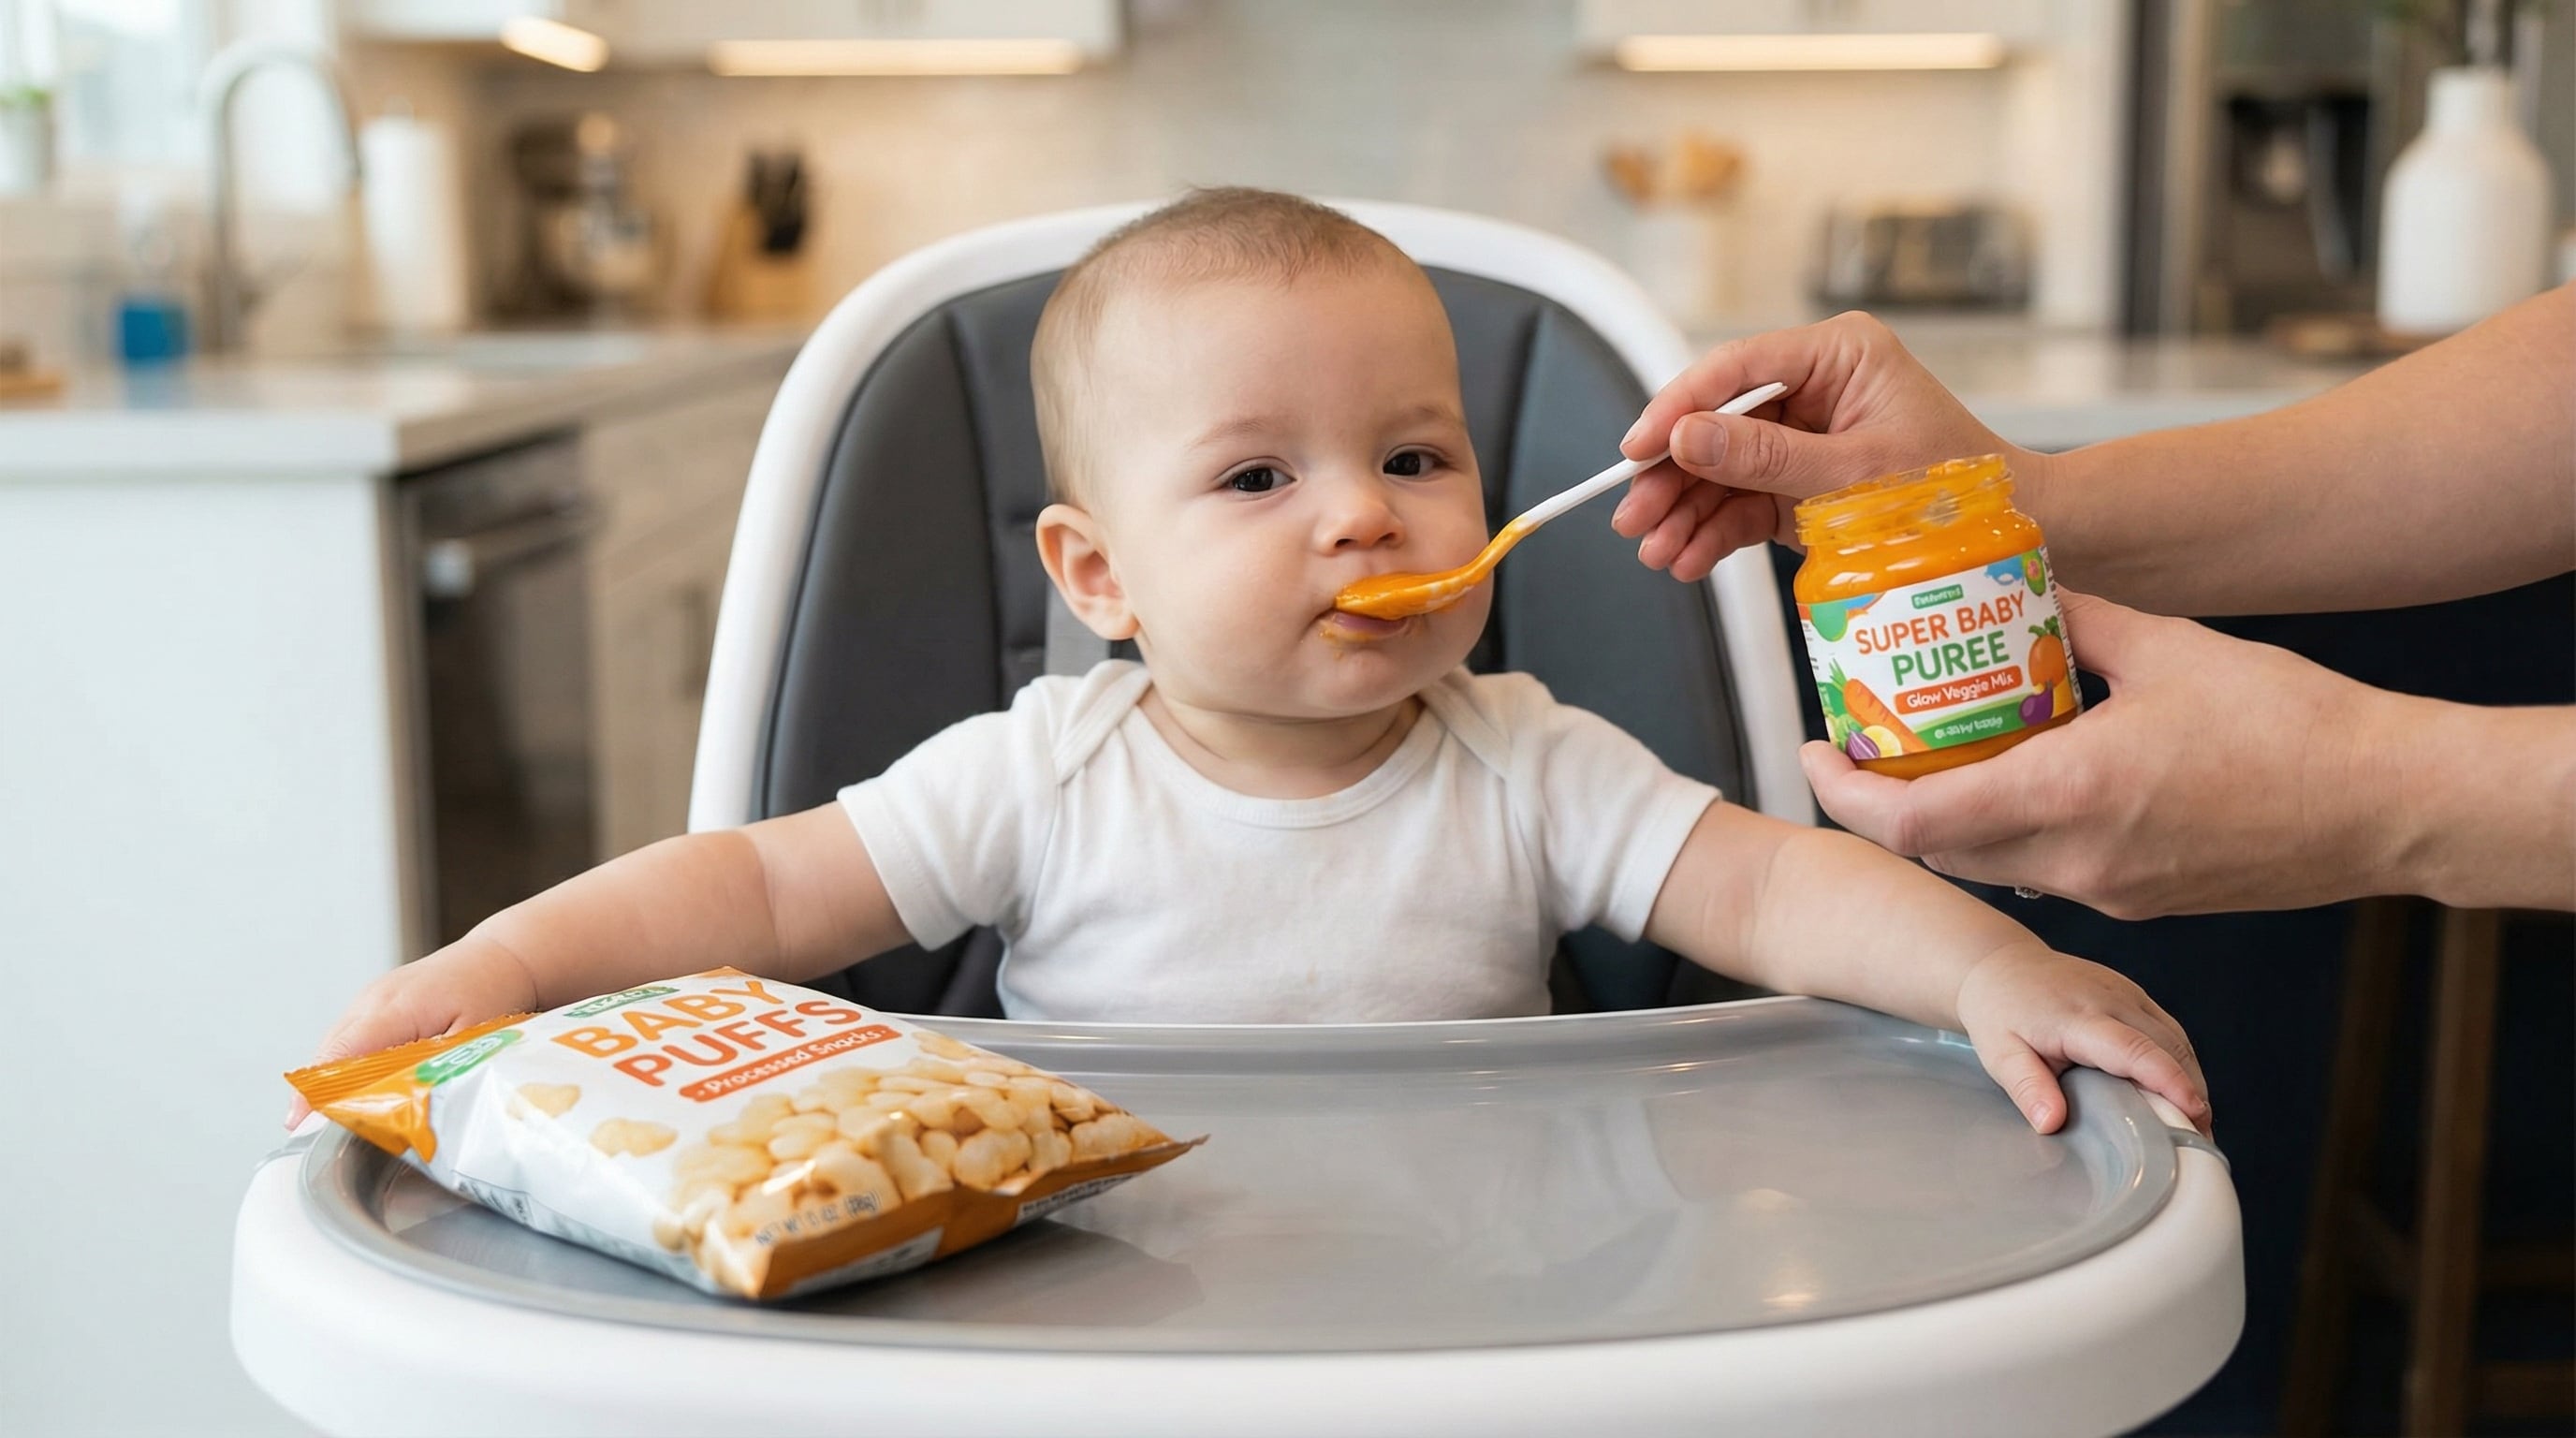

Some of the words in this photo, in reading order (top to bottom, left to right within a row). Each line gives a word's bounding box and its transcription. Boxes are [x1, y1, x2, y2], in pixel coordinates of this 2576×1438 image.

[1855, 613, 1949, 654] SUPER
[1956, 590, 2025, 634] BABY
[1891, 630, 2010, 686] PUREE
[1907, 692, 1941, 708] Glow
[1942, 680, 1989, 701] Veggie
[1990, 671, 2013, 689] Mix
[551, 980, 784, 1058] BABY
[613, 1001, 862, 1086] PUFFS
[705, 1050, 813, 1093] Processed
[812, 1029, 879, 1057] Snacks
